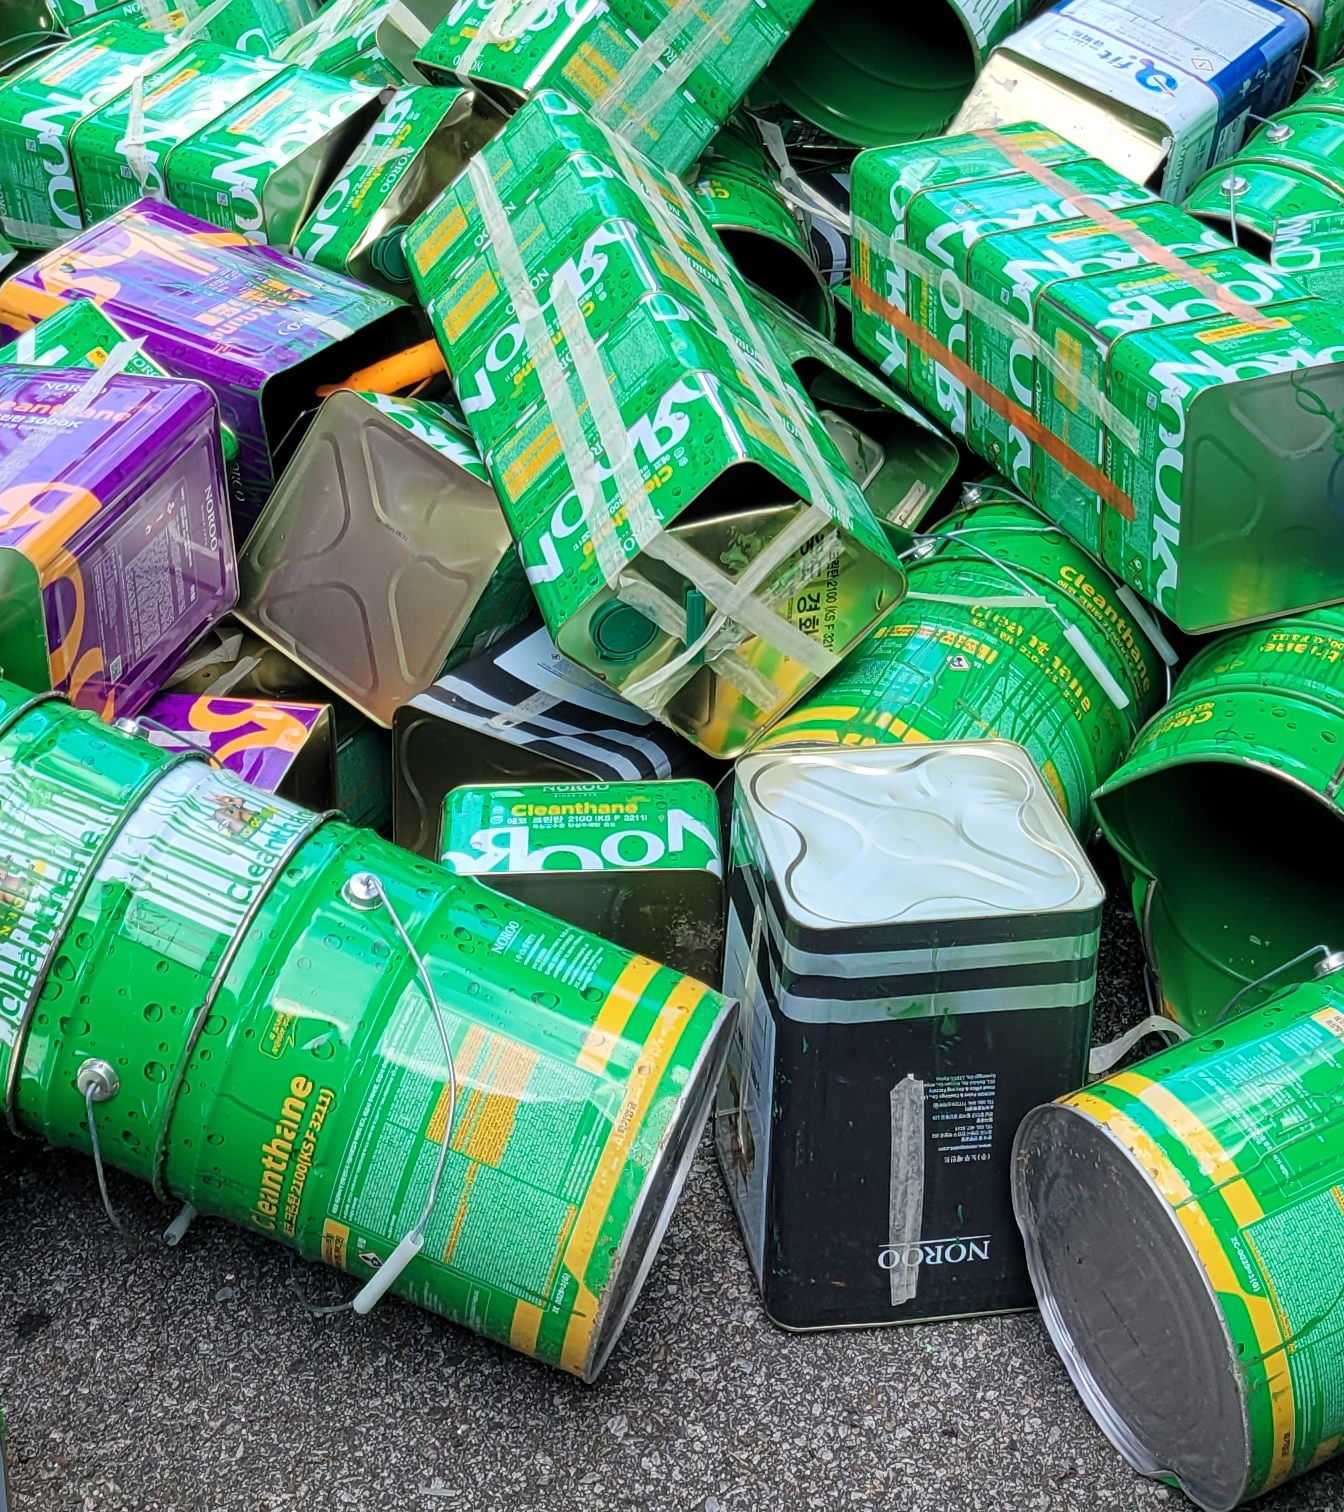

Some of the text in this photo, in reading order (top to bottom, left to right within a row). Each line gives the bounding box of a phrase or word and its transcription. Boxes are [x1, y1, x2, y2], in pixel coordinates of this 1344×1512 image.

[40, 380, 108, 396] NORO
[25, 415, 84, 430] 3000K
[204, 484, 218, 553] NOROO
[824, 579, 841, 603] 2100
[1059, 566, 1150, 691] Cleanthane
[512, 802, 639, 817] Cleanthane
[491, 919, 520, 956] NOROO
[310, 1088, 335, 1131] 3211)
[251, 1076, 313, 1230] Cleanthane
[878, 1239, 991, 1272] NOROO
